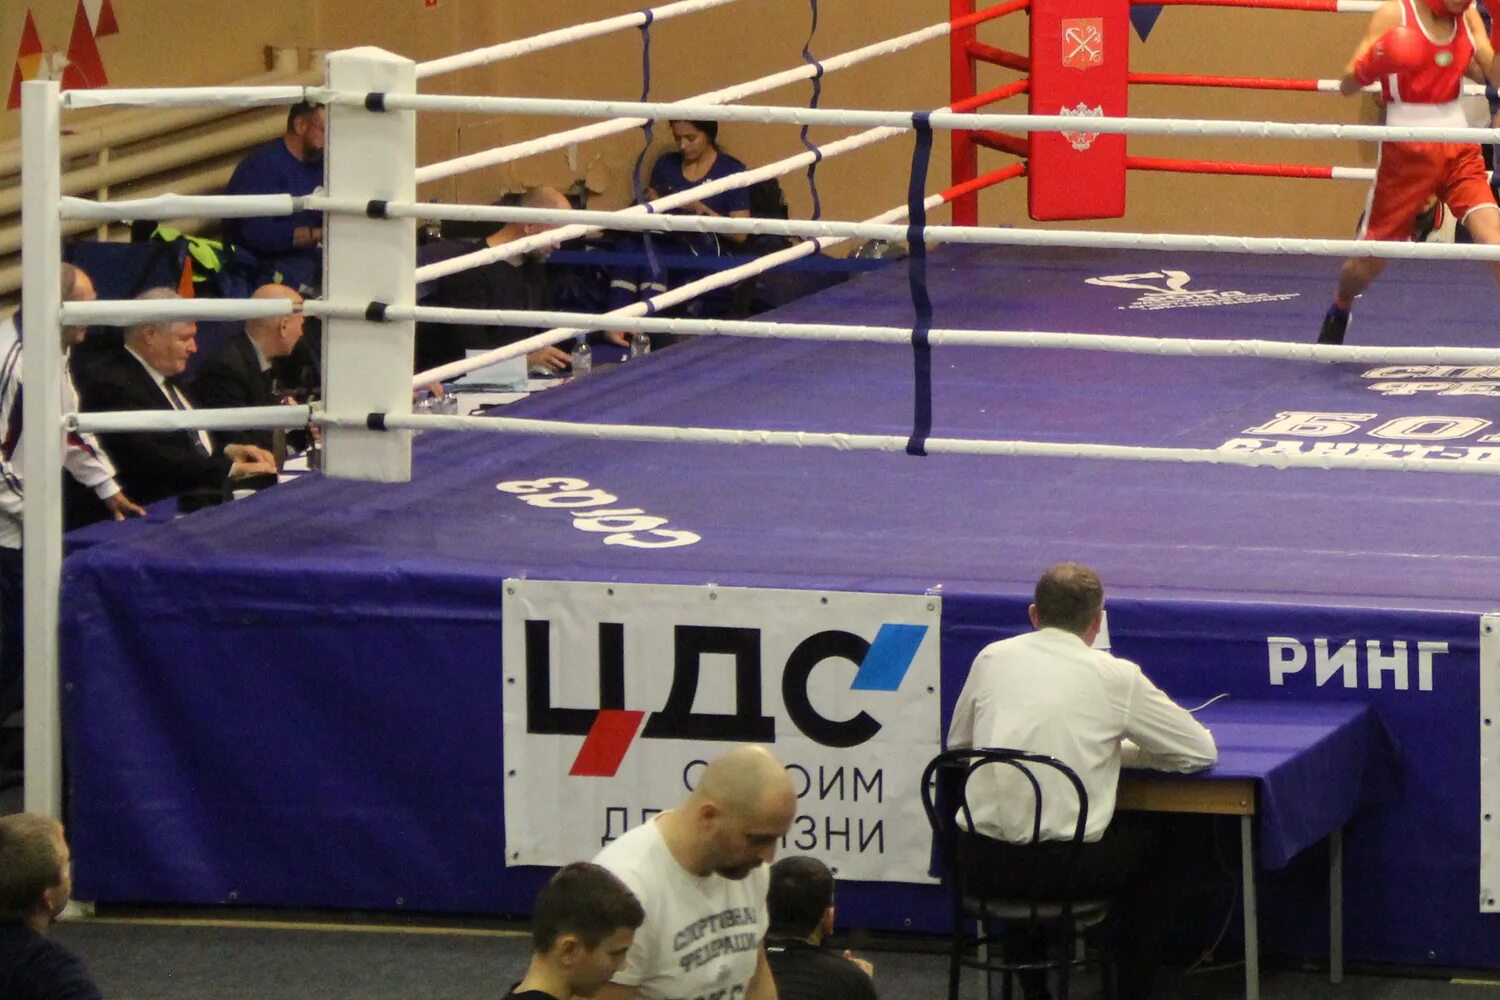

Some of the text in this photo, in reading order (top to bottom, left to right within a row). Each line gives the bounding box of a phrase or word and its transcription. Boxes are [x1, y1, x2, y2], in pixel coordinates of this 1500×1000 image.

[1267, 637, 1449, 691] РИНГ
[524, 620, 928, 777] ЦДС
[683, 760, 884, 804] СОИМ
[781, 815, 884, 854] ЗНИ
